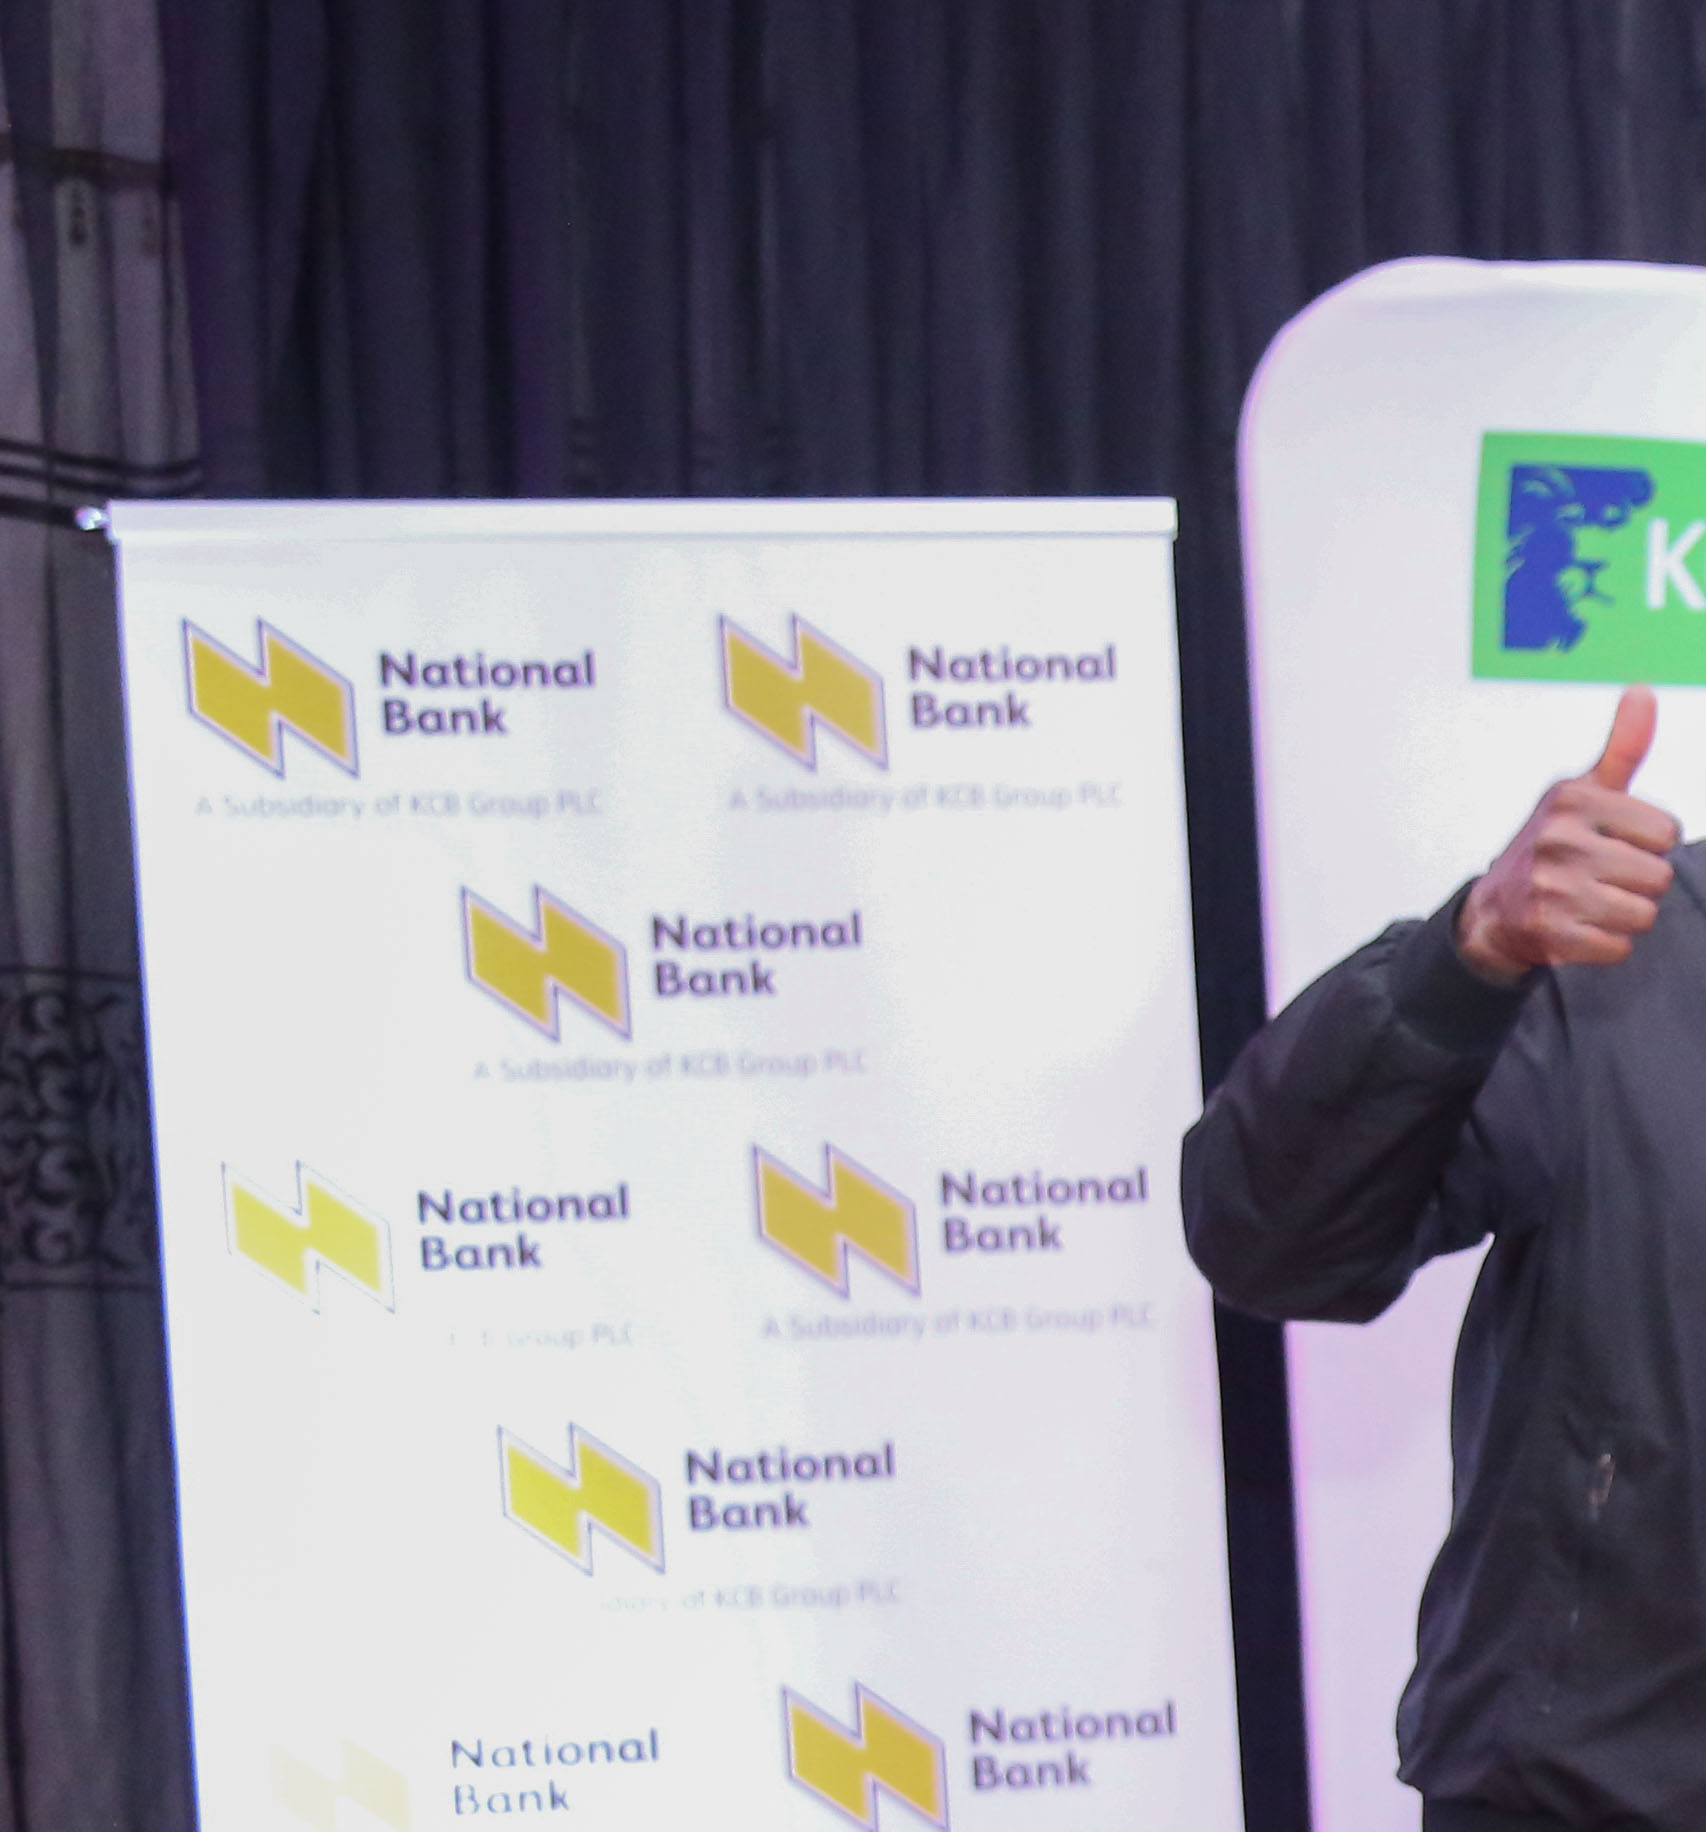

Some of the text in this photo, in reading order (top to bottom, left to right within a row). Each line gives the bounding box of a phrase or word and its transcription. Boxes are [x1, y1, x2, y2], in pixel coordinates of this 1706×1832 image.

[379, 651, 595, 689] National
[907, 644, 1116, 683] National
[382, 698, 506, 735] Bank
[910, 692, 1029, 728] Bank
[651, 911, 861, 951] National
[654, 960, 774, 997] Bank
[417, 1183, 629, 1224] National
[939, 1166, 1148, 1207] National
[421, 1233, 541, 1270] Bank
[942, 1215, 1060, 1254] Bank
[685, 1442, 895, 1485] National
[688, 1492, 808, 1531] Bank
[968, 1700, 1176, 1746] National
[451, 1728, 658, 1768] National
[971, 1751, 1088, 1791] Bank
[454, 1780, 569, 1815] Bank
